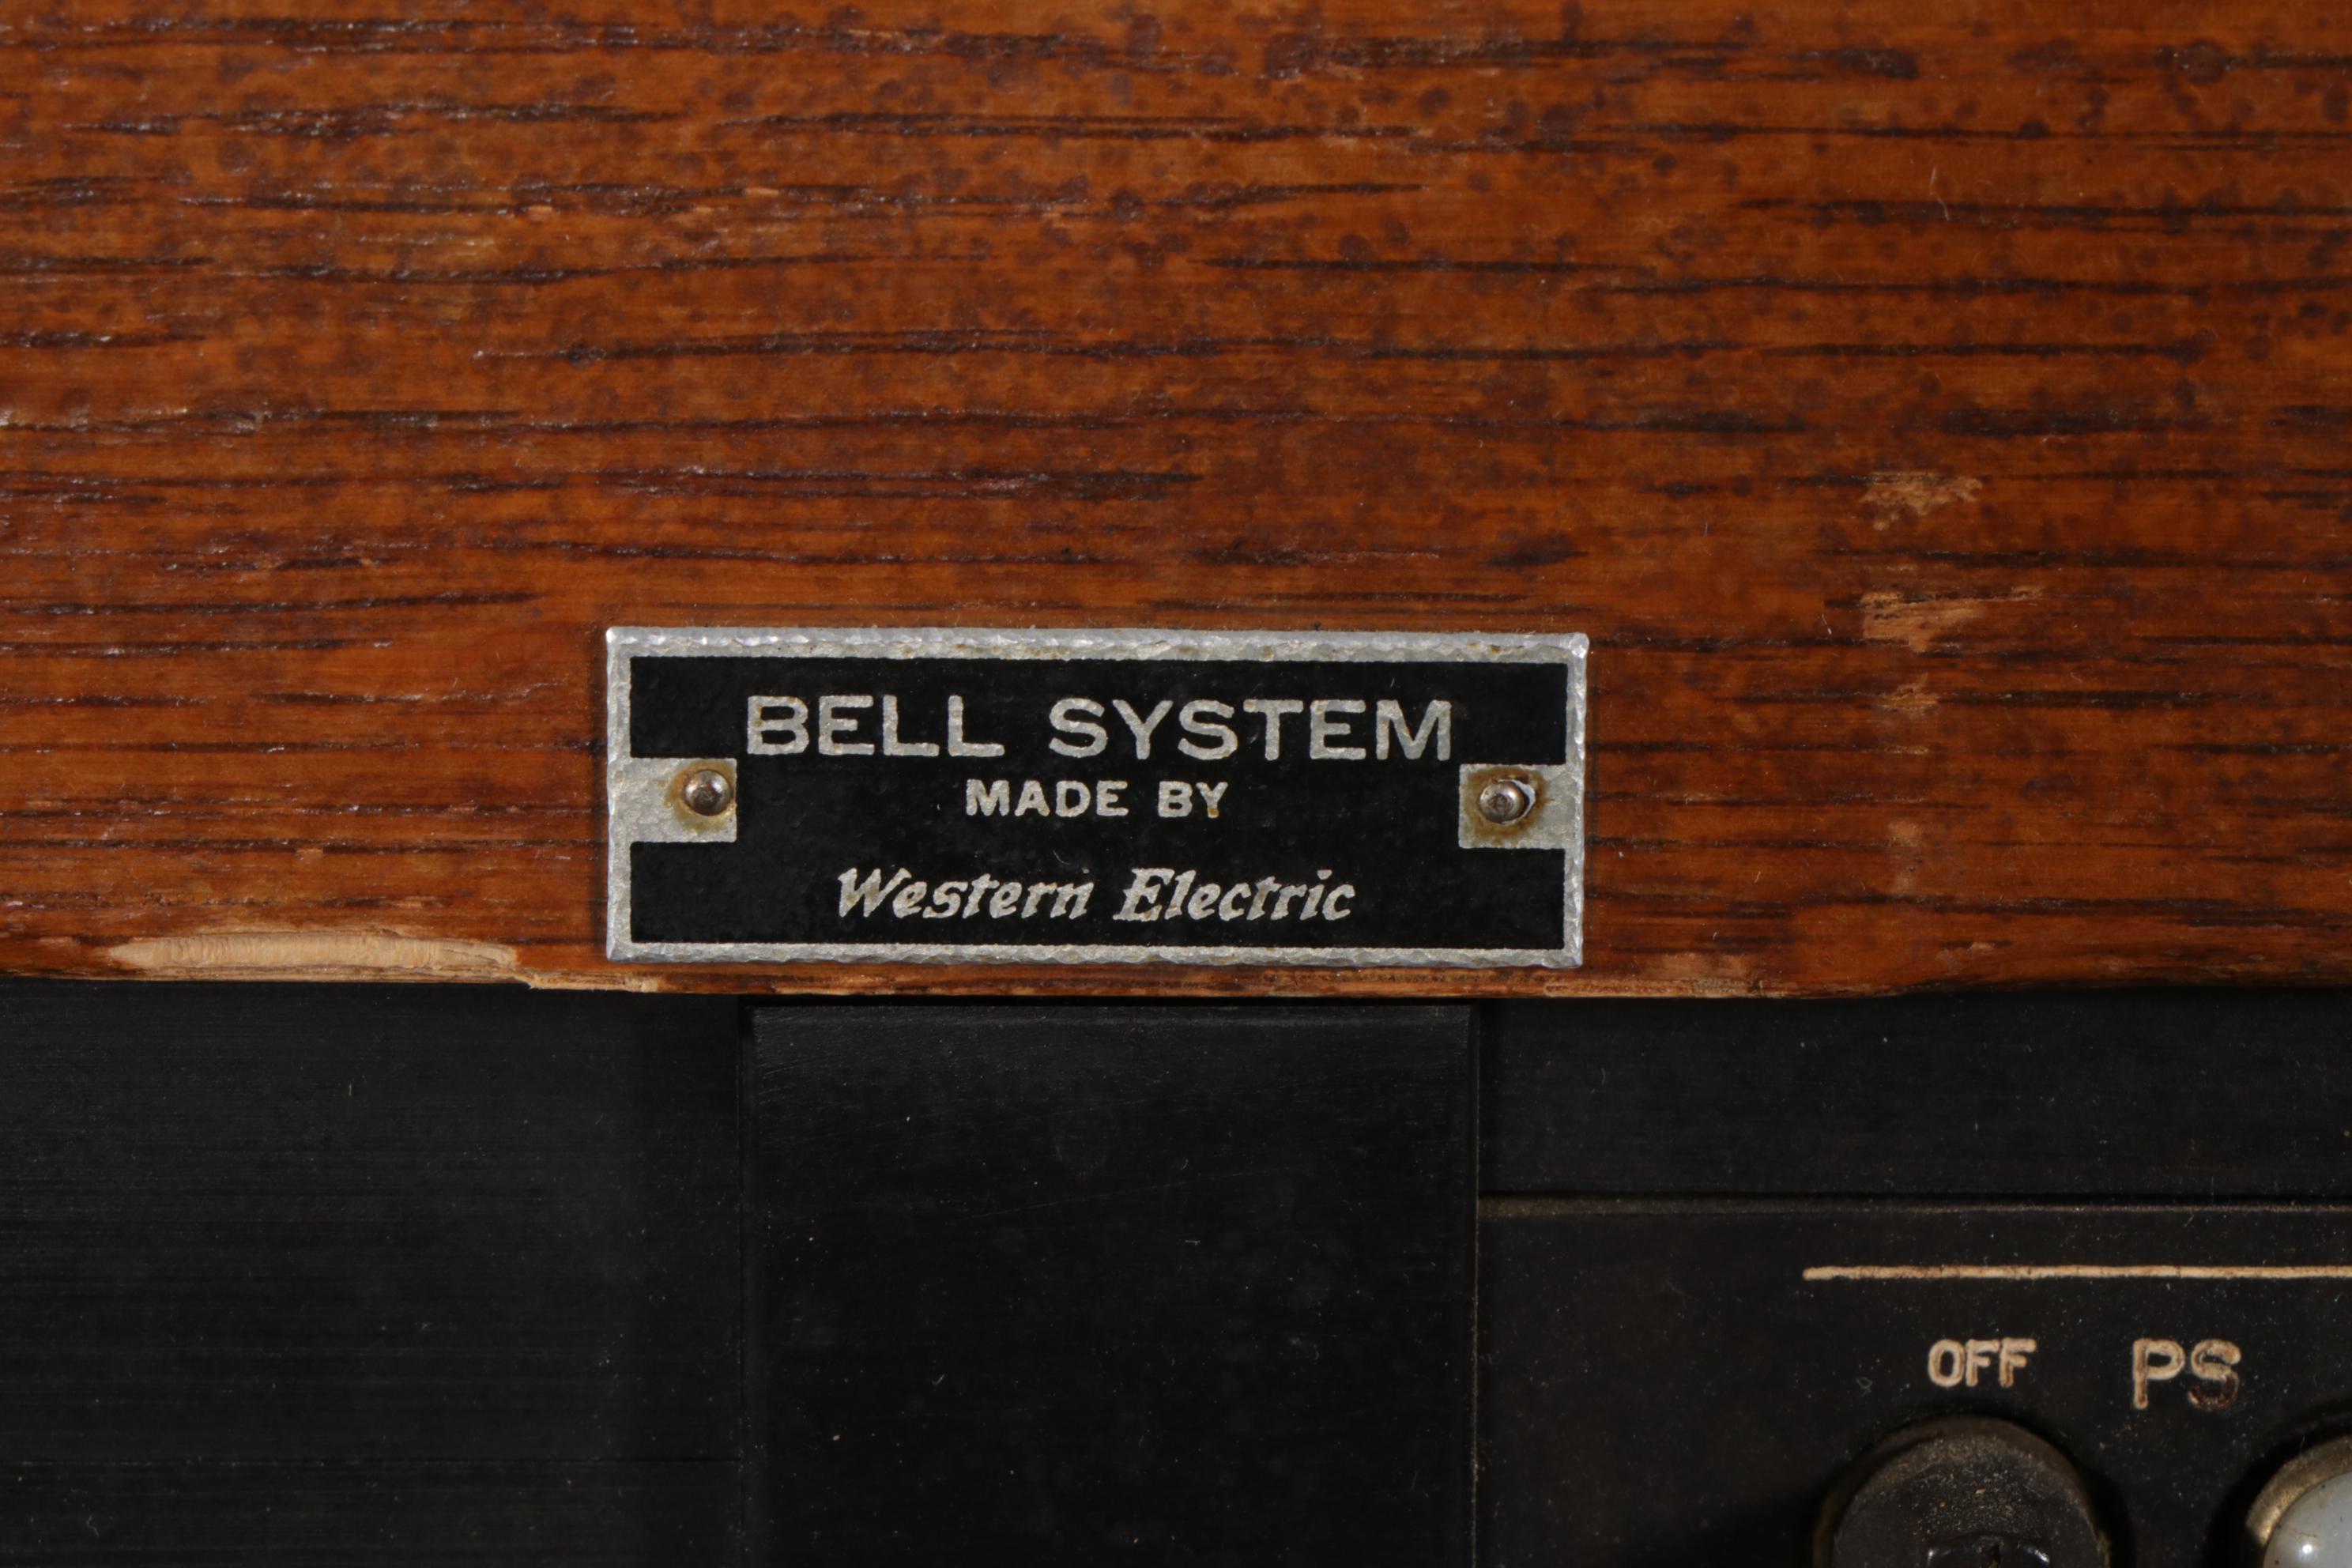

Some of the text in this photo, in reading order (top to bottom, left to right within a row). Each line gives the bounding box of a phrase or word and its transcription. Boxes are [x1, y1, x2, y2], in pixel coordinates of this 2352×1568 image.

[747, 695, 1453, 761] BELL SYSTEM
[965, 779, 1230, 819] MADE BY
[837, 866, 1356, 922] Western Electric
[1928, 1339, 2037, 1388] OFF
[2132, 1338, 2242, 1410] PS
